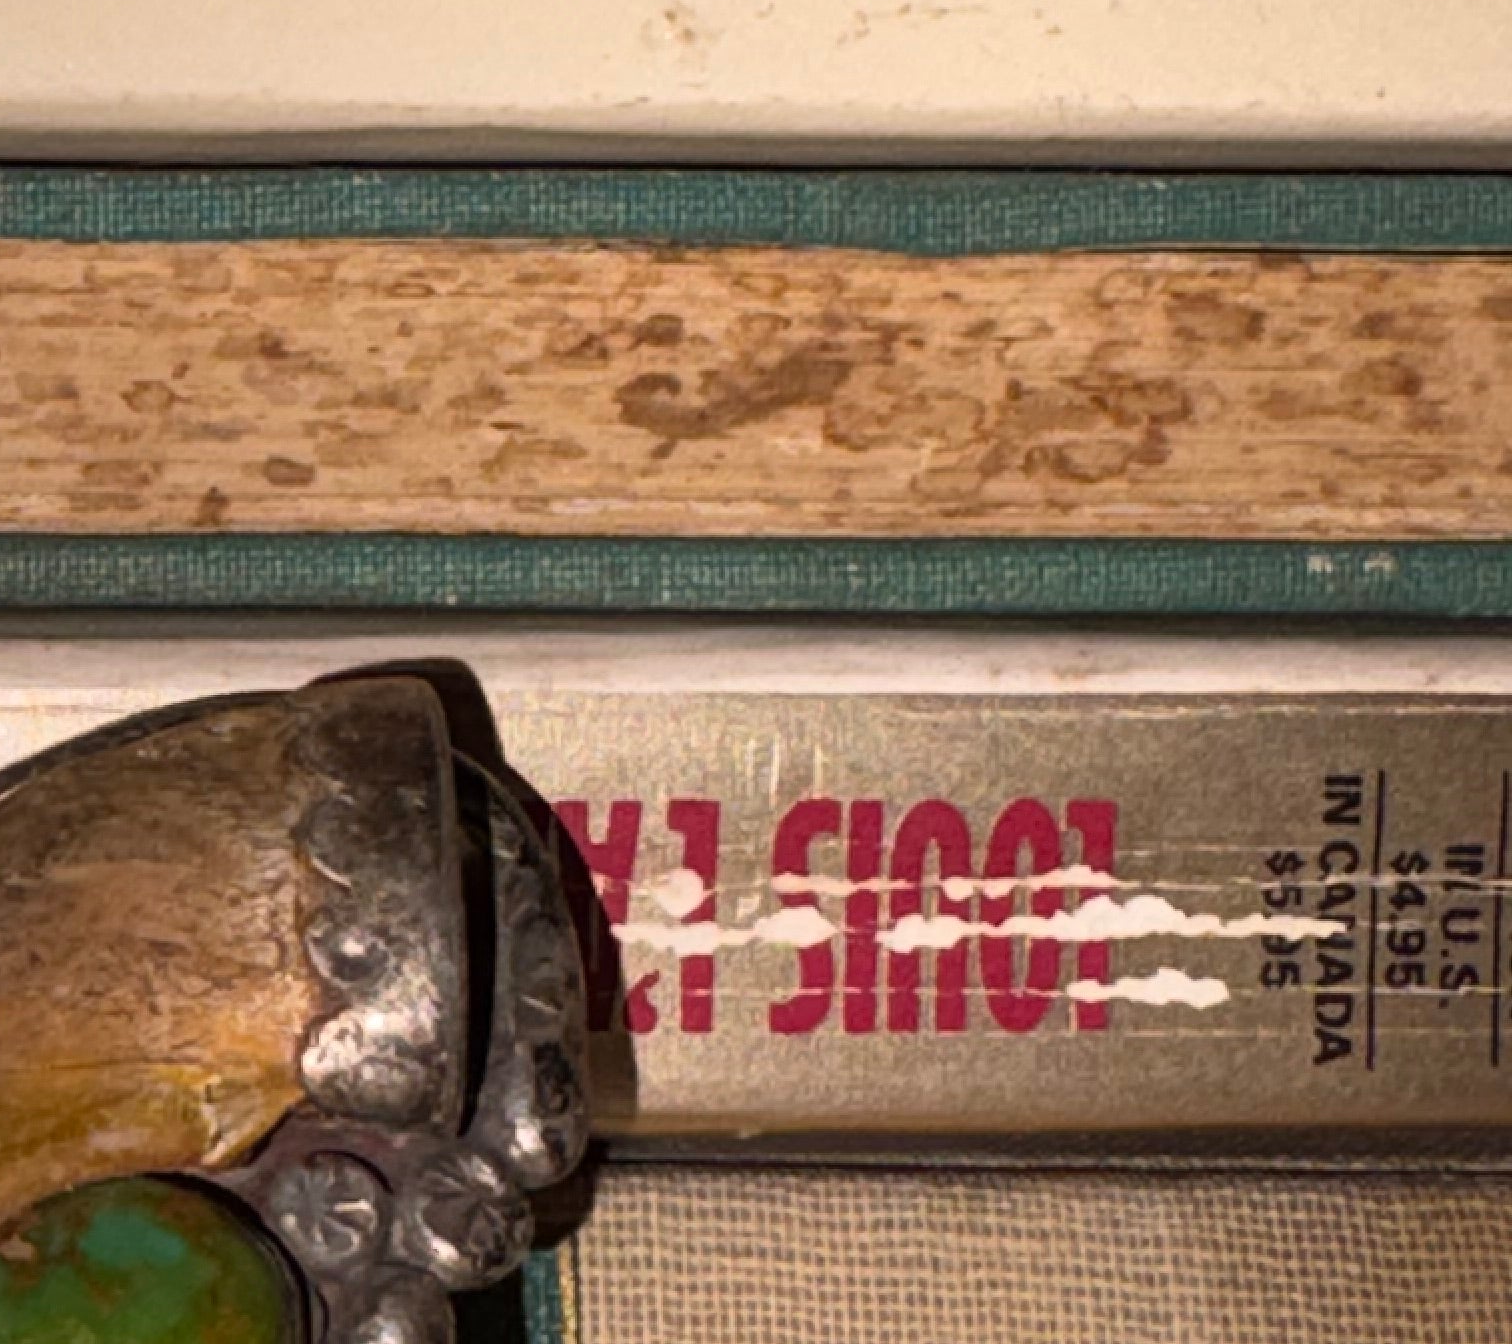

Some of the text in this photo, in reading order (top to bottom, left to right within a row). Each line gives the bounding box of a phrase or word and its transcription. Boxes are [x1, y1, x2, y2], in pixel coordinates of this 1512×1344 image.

[769, 797, 1117, 1035] LOUIS
[1311, 774, 1364, 1066] IN CANADA
[1383, 849, 1432, 989] $4.95
